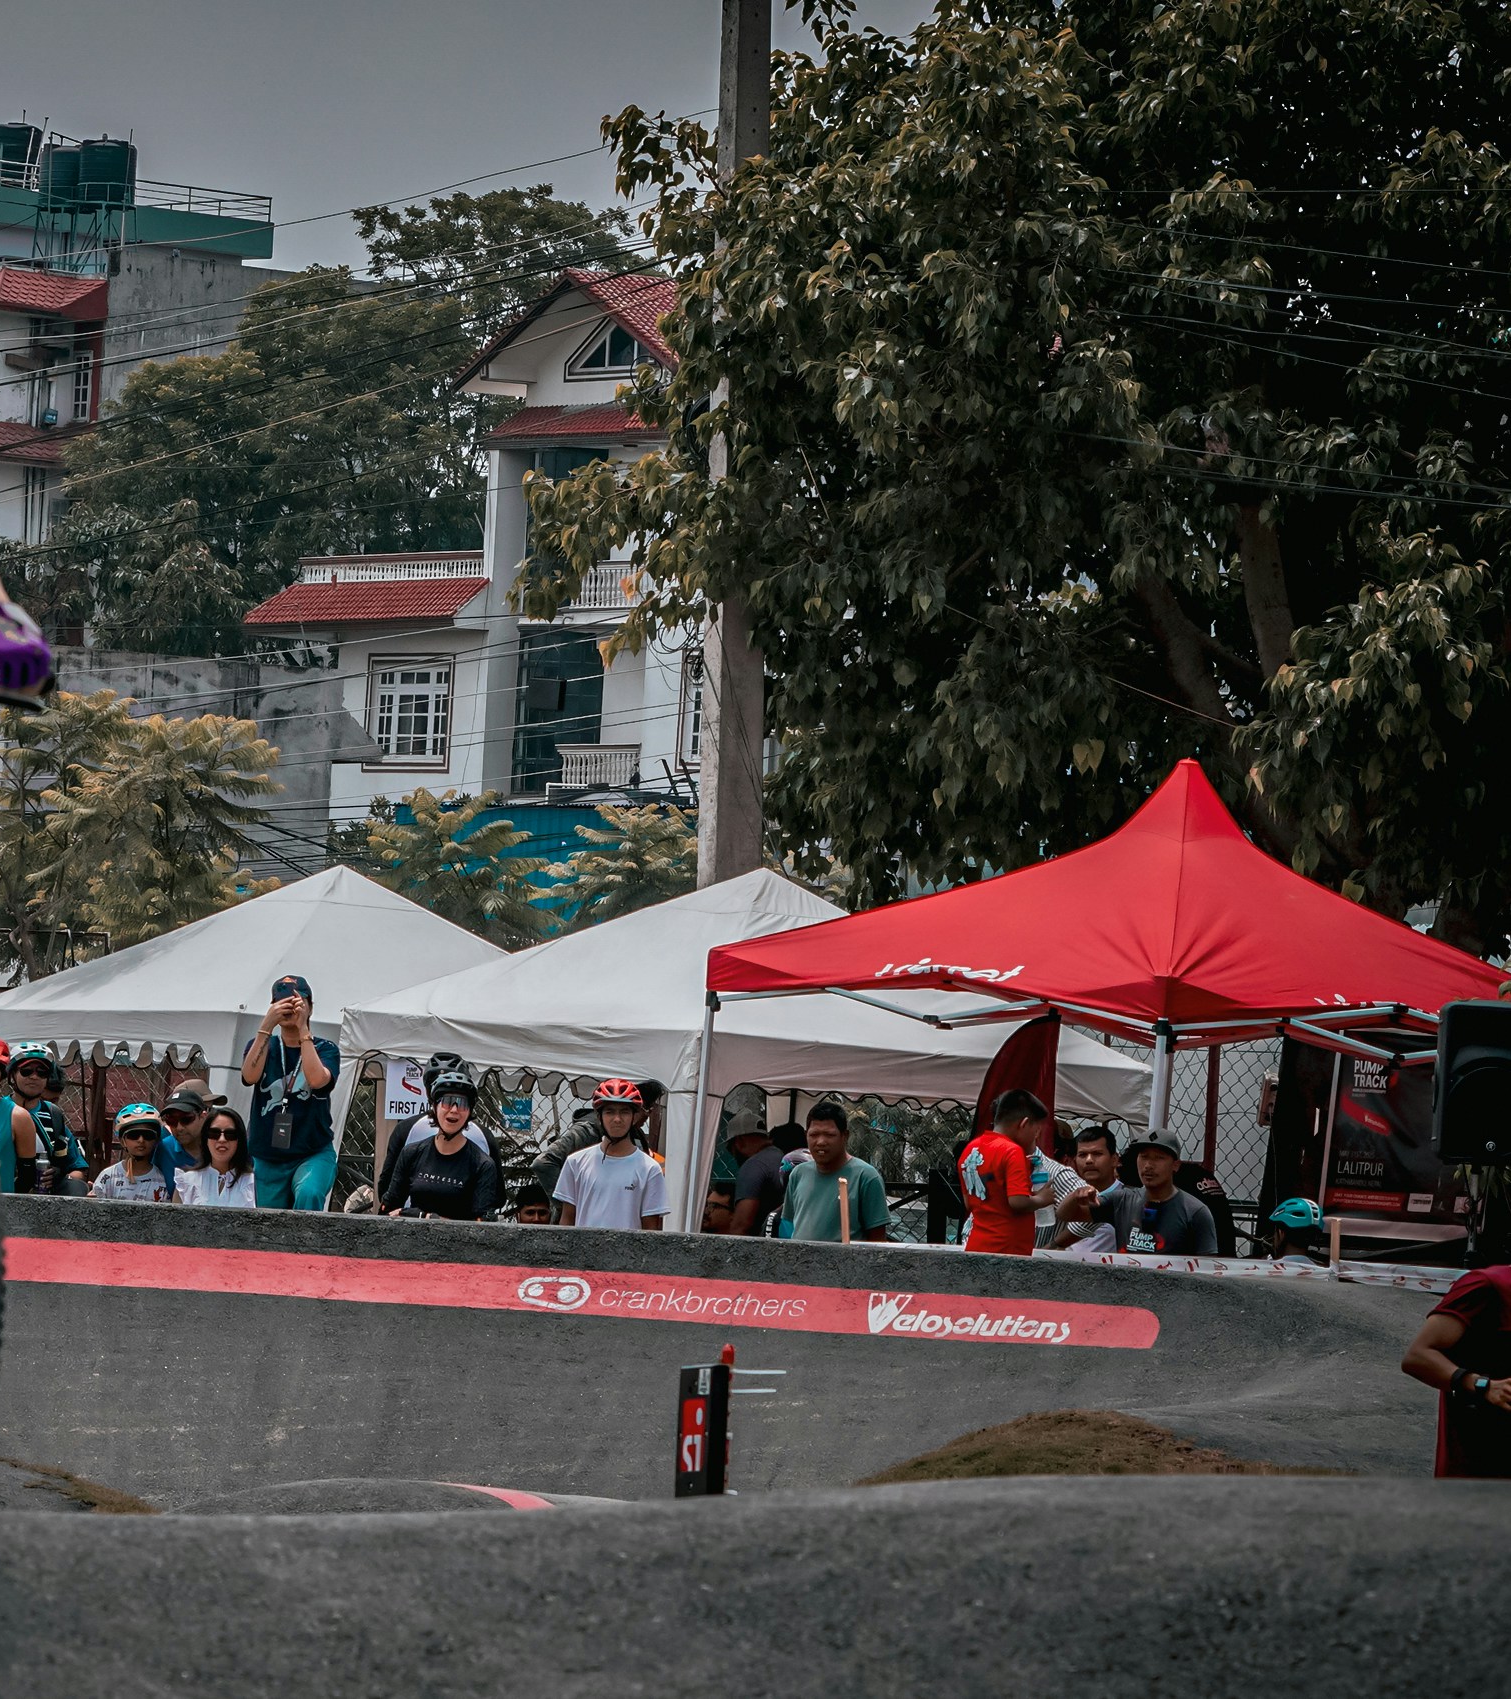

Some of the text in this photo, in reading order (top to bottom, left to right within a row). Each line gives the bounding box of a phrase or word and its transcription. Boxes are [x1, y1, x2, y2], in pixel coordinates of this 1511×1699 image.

[1354, 1059, 1384, 1074] PUMP
[1353, 1074, 1388, 1089] TRACK
[389, 1101, 417, 1114] FIRST
[1337, 1161, 1384, 1176] LALITPUR
[1129, 1231, 1154, 1241] PUMP
[1129, 1239, 1156, 1249] TRACK
[599, 1288, 807, 1317] crankbrothers
[867, 1292, 1071, 1343] Velosolutions
